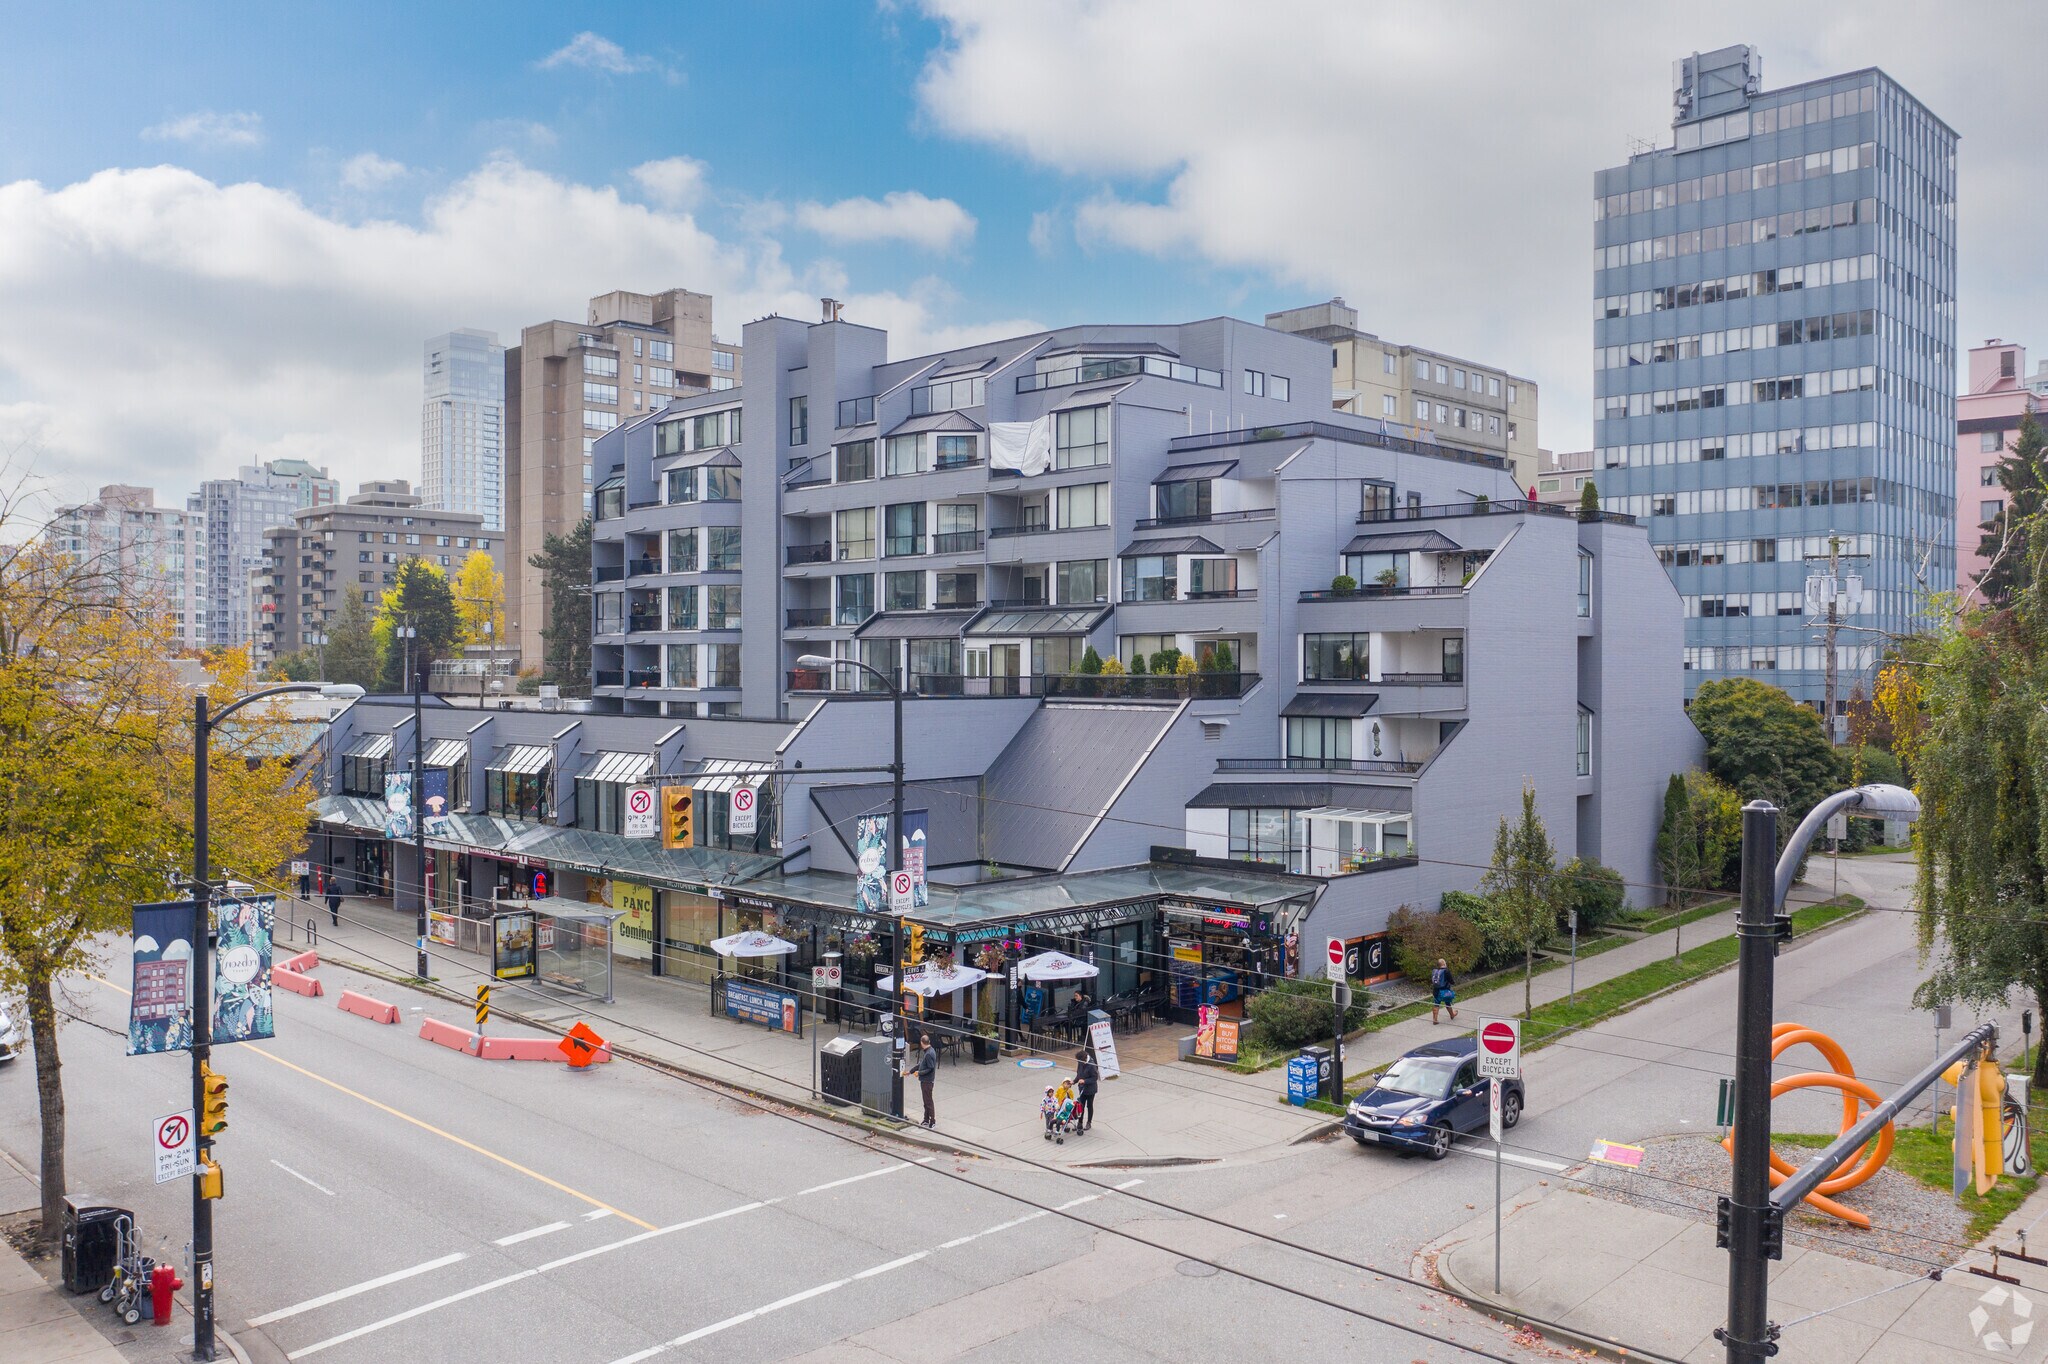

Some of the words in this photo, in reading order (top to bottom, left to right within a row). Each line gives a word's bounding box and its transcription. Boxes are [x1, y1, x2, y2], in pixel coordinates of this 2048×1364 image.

[623, 896, 653, 913] PANC
[895, 897, 910, 905] EXCEPT
[620, 921, 653, 944] Coming
[1009, 966, 1018, 990] WINGS
[1216, 1037, 1238, 1045] BITCOIN
[1219, 1044, 1234, 1052] HERE
[1485, 1056, 1512, 1066] EXCEPT
[1482, 1065, 1515, 1075] BICYCLES
[158, 1170, 176, 1181] EXCEPT
[178, 1165, 193, 1175] BUSES
